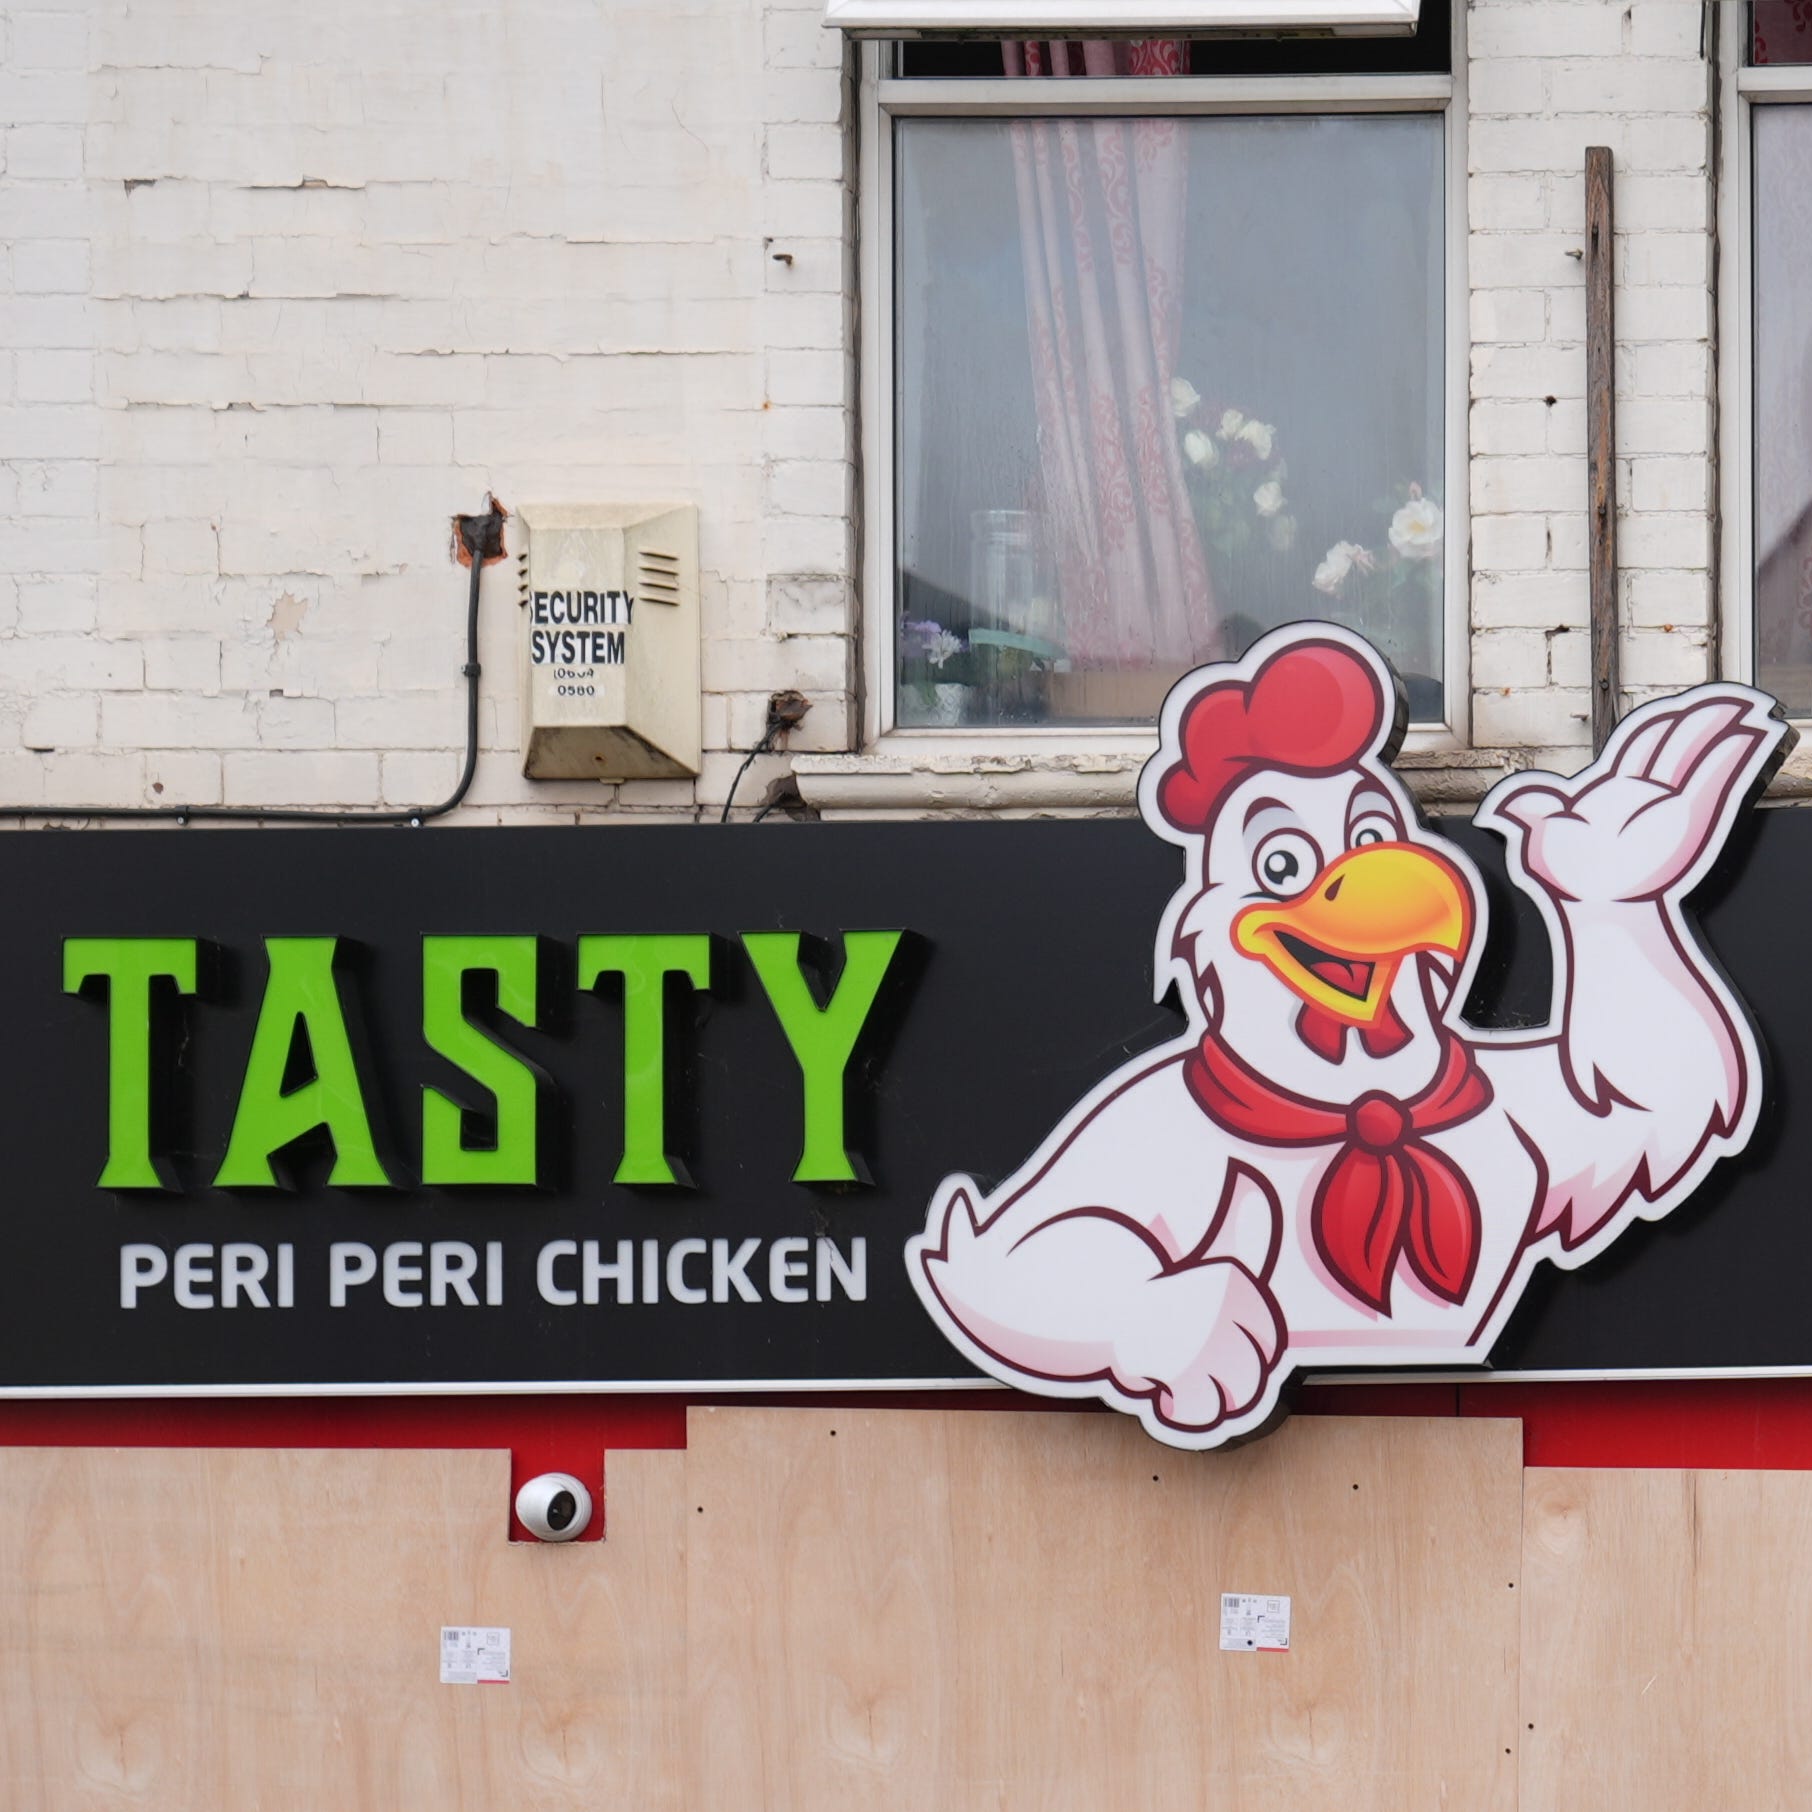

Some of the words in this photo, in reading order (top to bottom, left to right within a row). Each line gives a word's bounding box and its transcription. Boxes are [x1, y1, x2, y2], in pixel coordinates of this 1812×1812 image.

[530, 591, 634, 625] ECURITY
[532, 630, 625, 664] SYSTEM
[62, 930, 901, 1188] TASTY
[120, 1244, 294, 1309] PERI
[330, 1242, 503, 1307] PERI
[536, 1238, 867, 1306] CHICKEN
